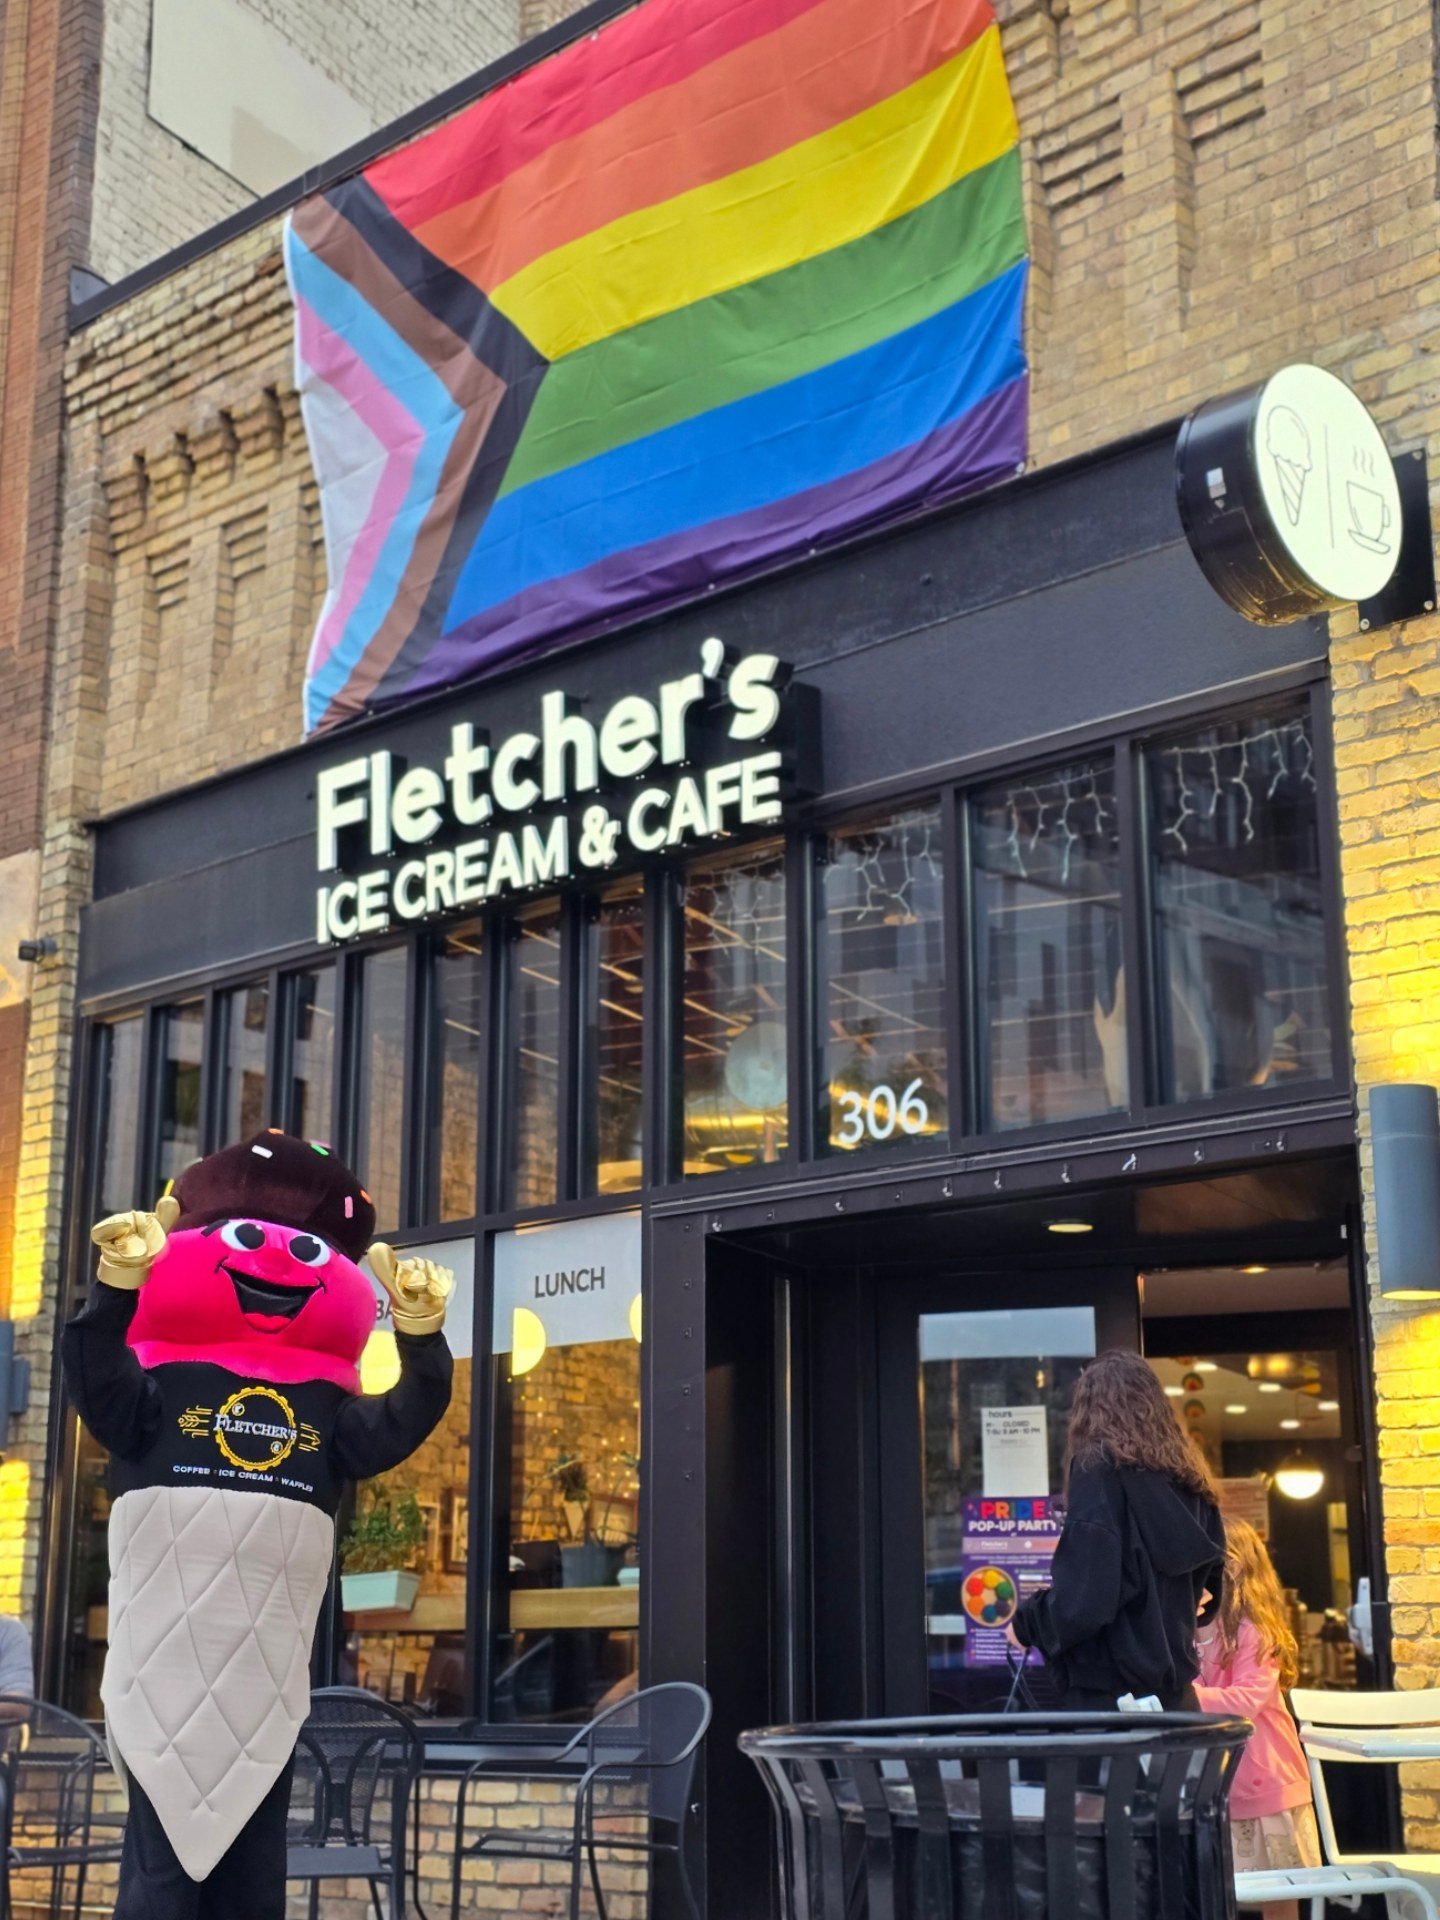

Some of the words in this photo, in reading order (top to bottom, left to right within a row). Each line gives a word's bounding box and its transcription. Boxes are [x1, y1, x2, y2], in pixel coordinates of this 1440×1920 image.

[317, 636, 780, 872] Fletcher's
[317, 870, 389, 944] ICE
[393, 817, 569, 920] CREAM
[579, 805, 621, 867] &
[629, 752, 783, 852] CAFE
[838, 1077, 929, 1144] 306
[534, 1266, 606, 1299] LUNCH
[213, 1413, 297, 1440] FLETCHER'S
[172, 1464, 211, 1475] COFFEE
[218, 1468, 236, 1478] ICE
[238, 1470, 274, 1483] CREAM
[981, 1500, 1046, 1520] PRIDE
[968, 1520, 1015, 1532] POP-UP
[1018, 1519, 1057, 1531] PARTY
